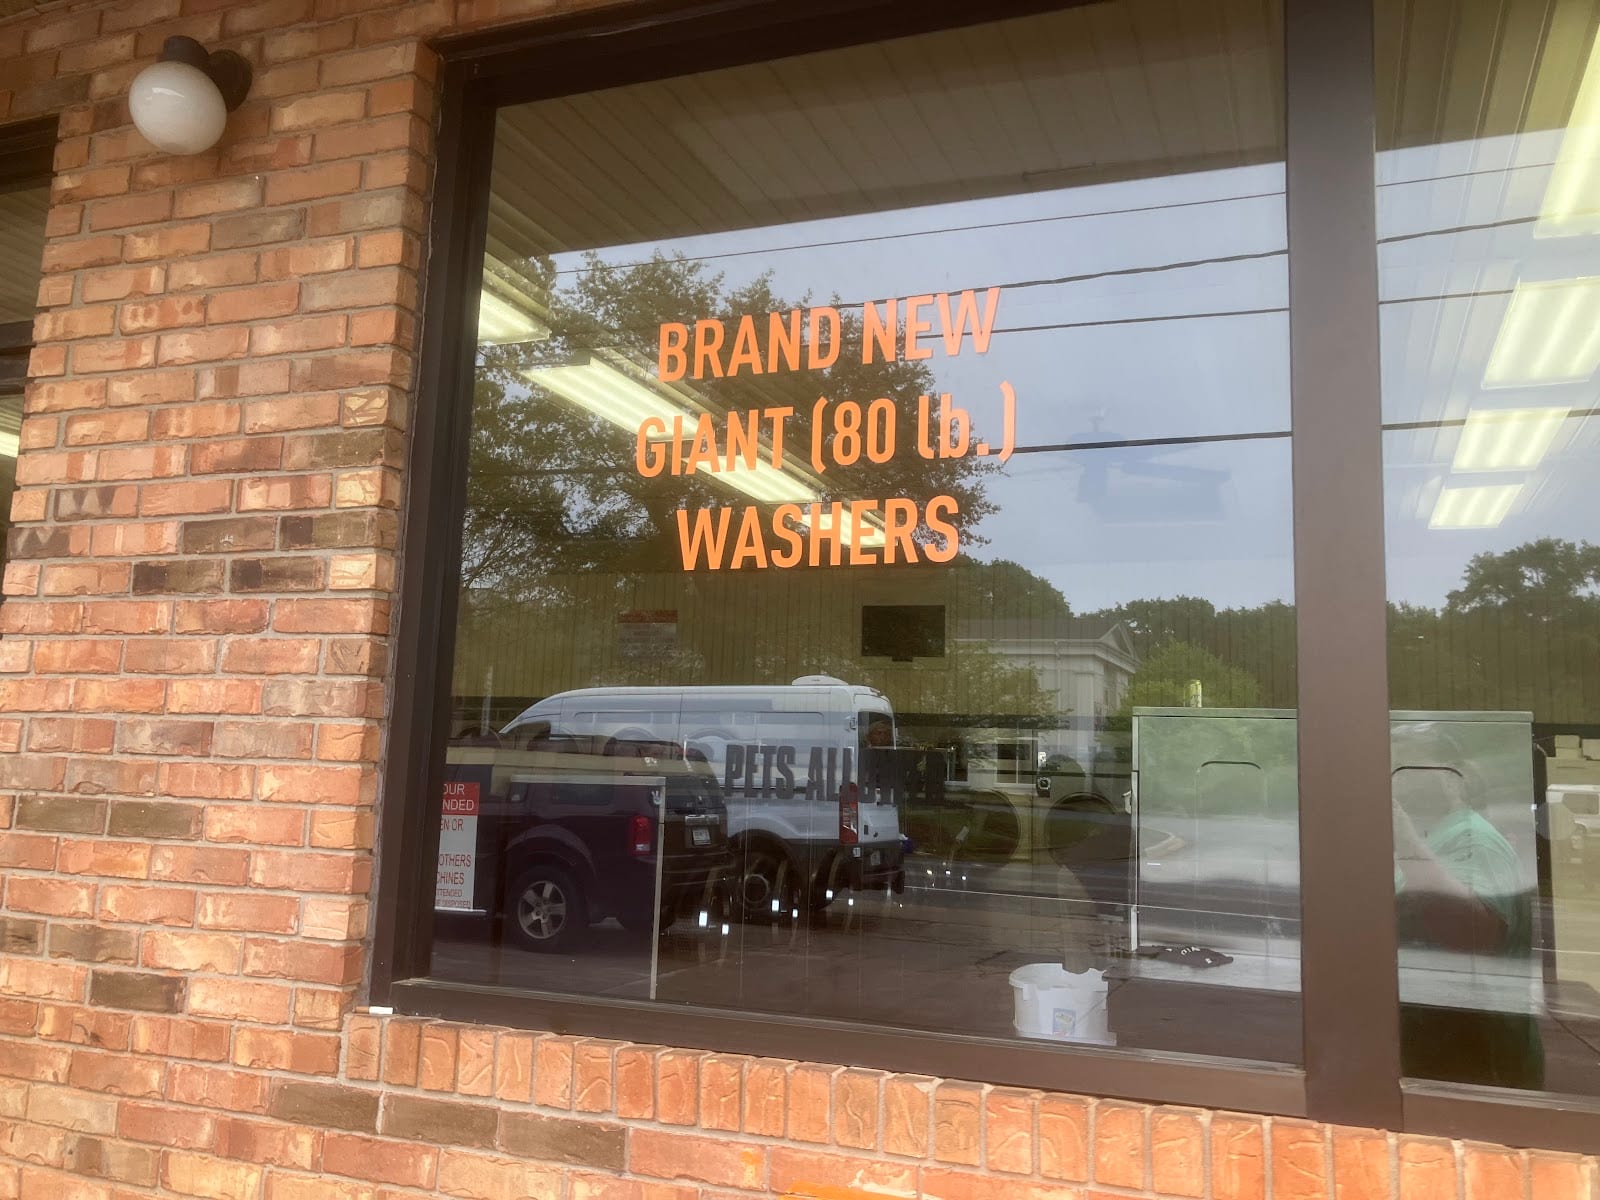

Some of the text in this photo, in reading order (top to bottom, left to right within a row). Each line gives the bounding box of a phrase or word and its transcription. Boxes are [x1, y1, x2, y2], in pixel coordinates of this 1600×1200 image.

[658, 286, 1001, 383] BRAND NEW
[636, 380, 1017, 478] GIANT (80 lb.)
[676, 495, 960, 571] WASHERS
[724, 744, 796, 800] PETS
[442, 799, 475, 811] NDED
[451, 818, 464, 832] OR
[439, 854, 472, 868] OTHERS
